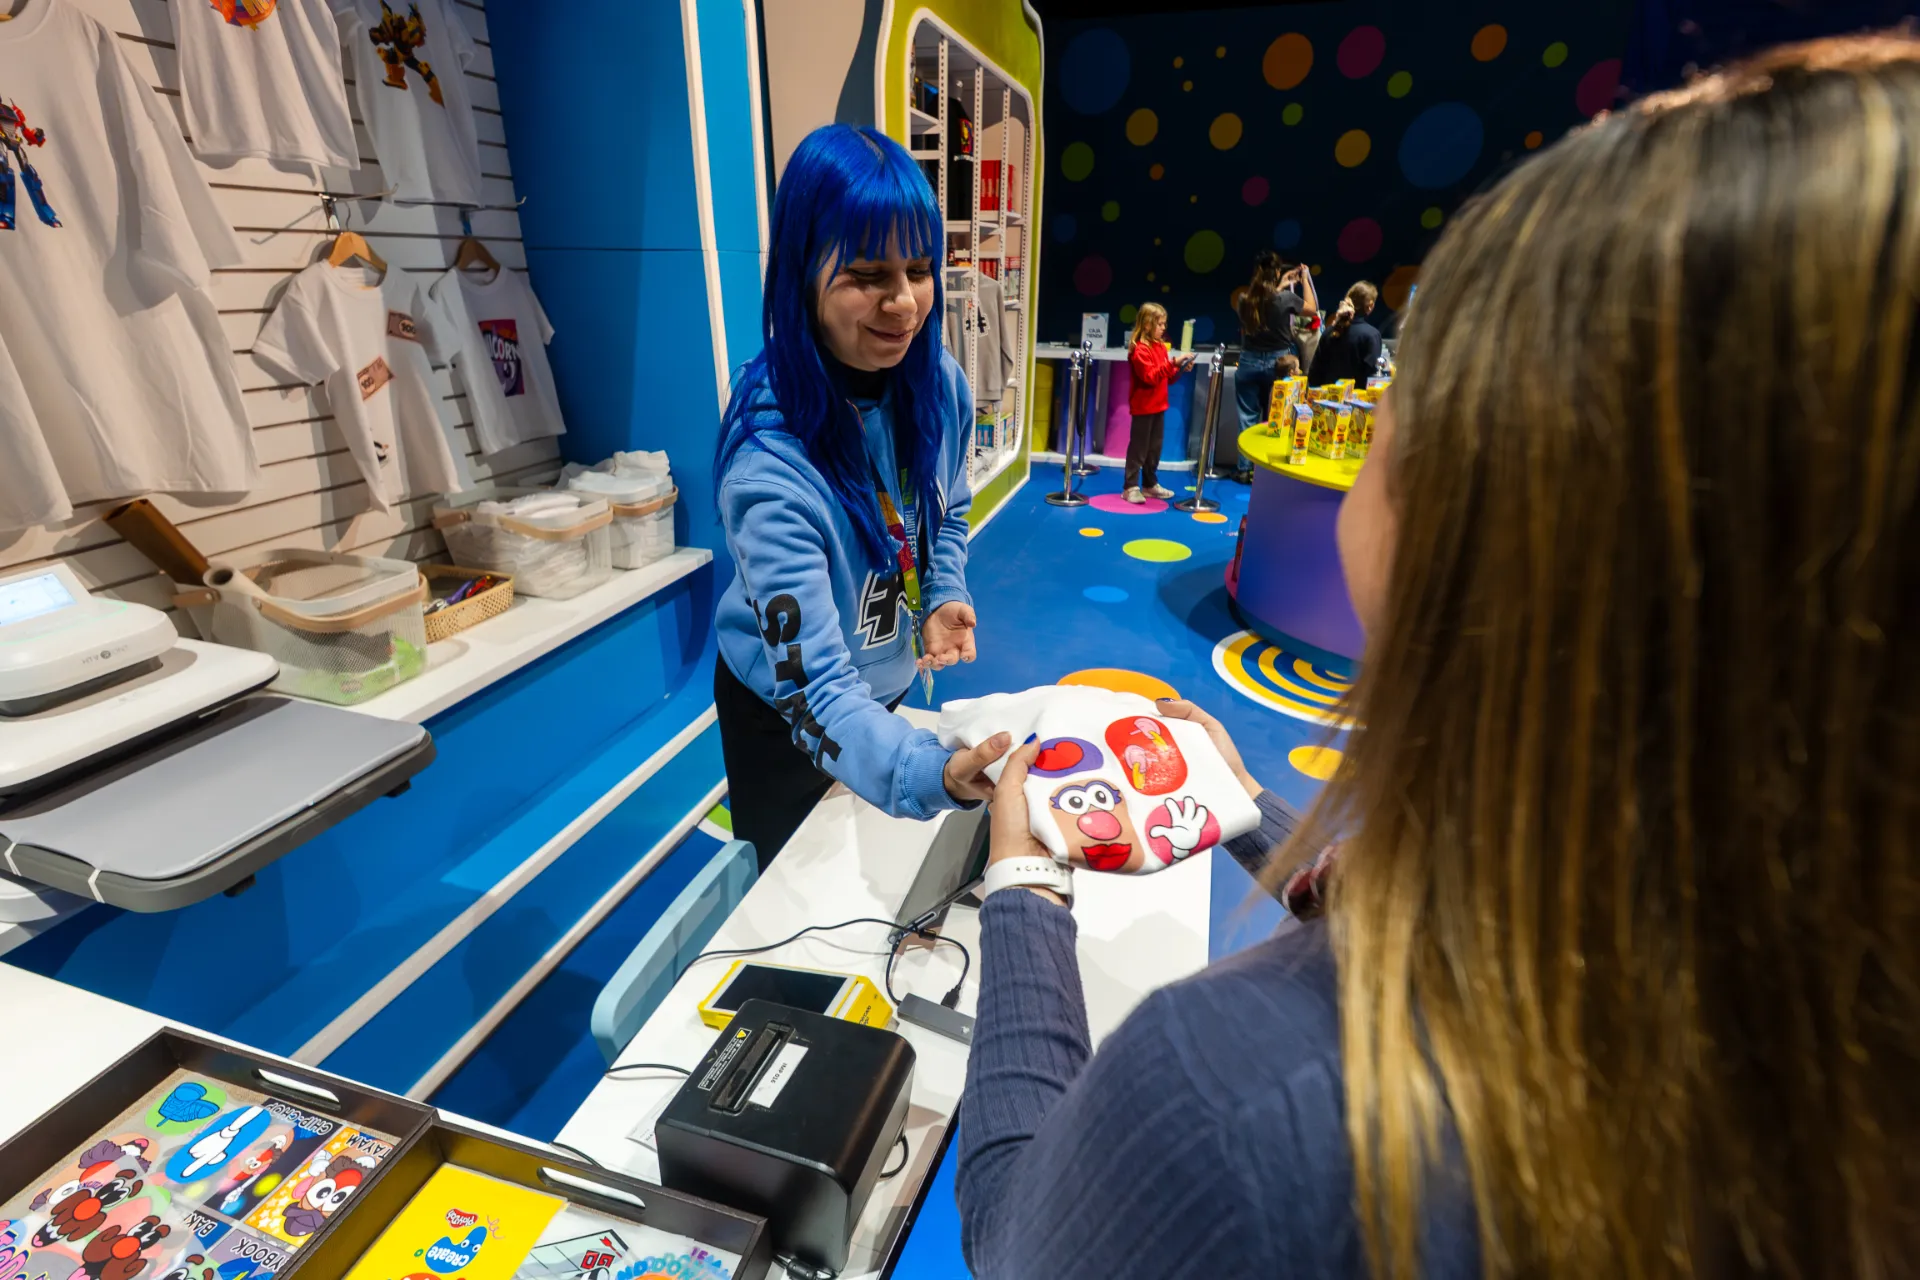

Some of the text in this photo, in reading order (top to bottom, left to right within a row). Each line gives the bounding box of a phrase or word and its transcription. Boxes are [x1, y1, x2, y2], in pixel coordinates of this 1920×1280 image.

[904, 509, 916, 534] FAMILY
[231, 1238, 288, 1272] YBOOK
[580, 1250, 615, 1269] GO
